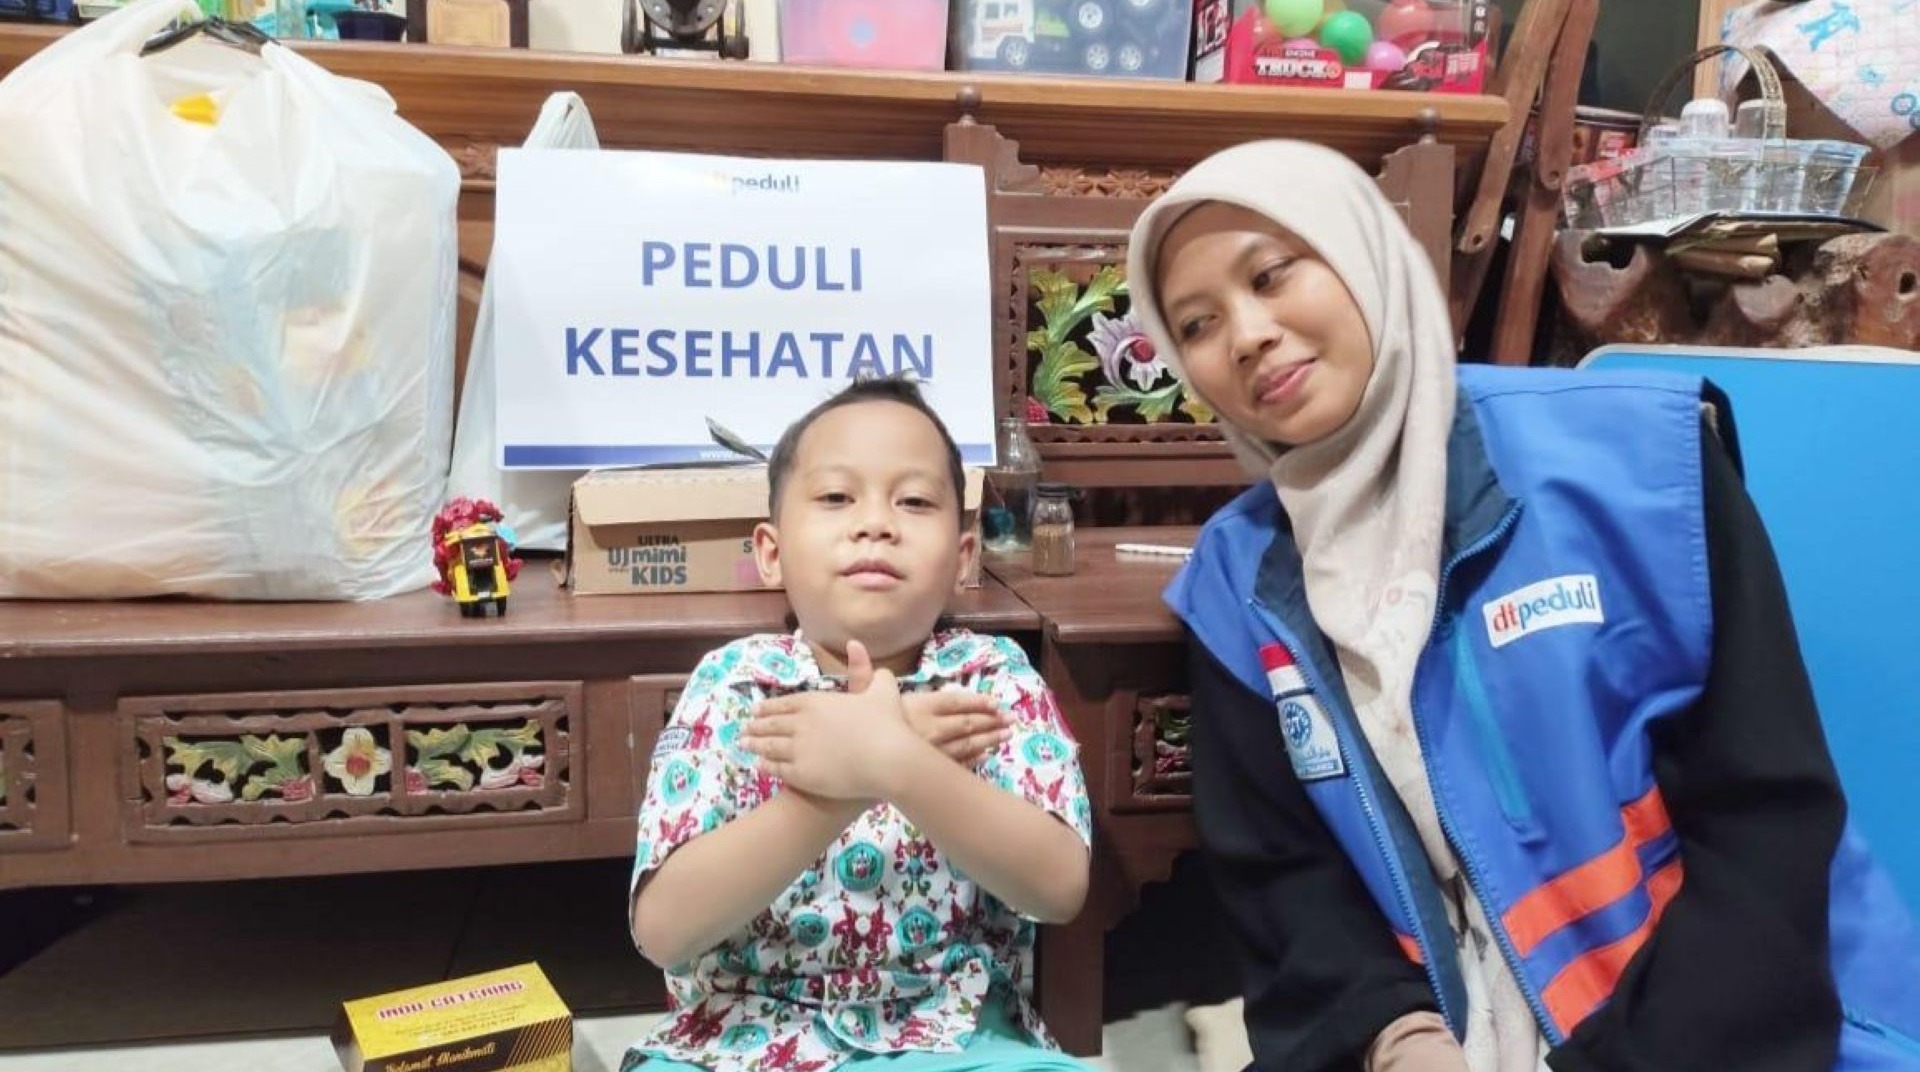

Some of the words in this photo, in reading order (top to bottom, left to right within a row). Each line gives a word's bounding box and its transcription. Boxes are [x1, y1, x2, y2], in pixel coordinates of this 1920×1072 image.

[712, 172, 799, 194] peduli
[641, 240, 863, 292] PEDULI
[564, 326, 935, 379] KESEHATAN
[631, 545, 687, 564] mimi
[631, 565, 688, 585] KIDS
[1493, 581, 1597, 632] dtpeduli
